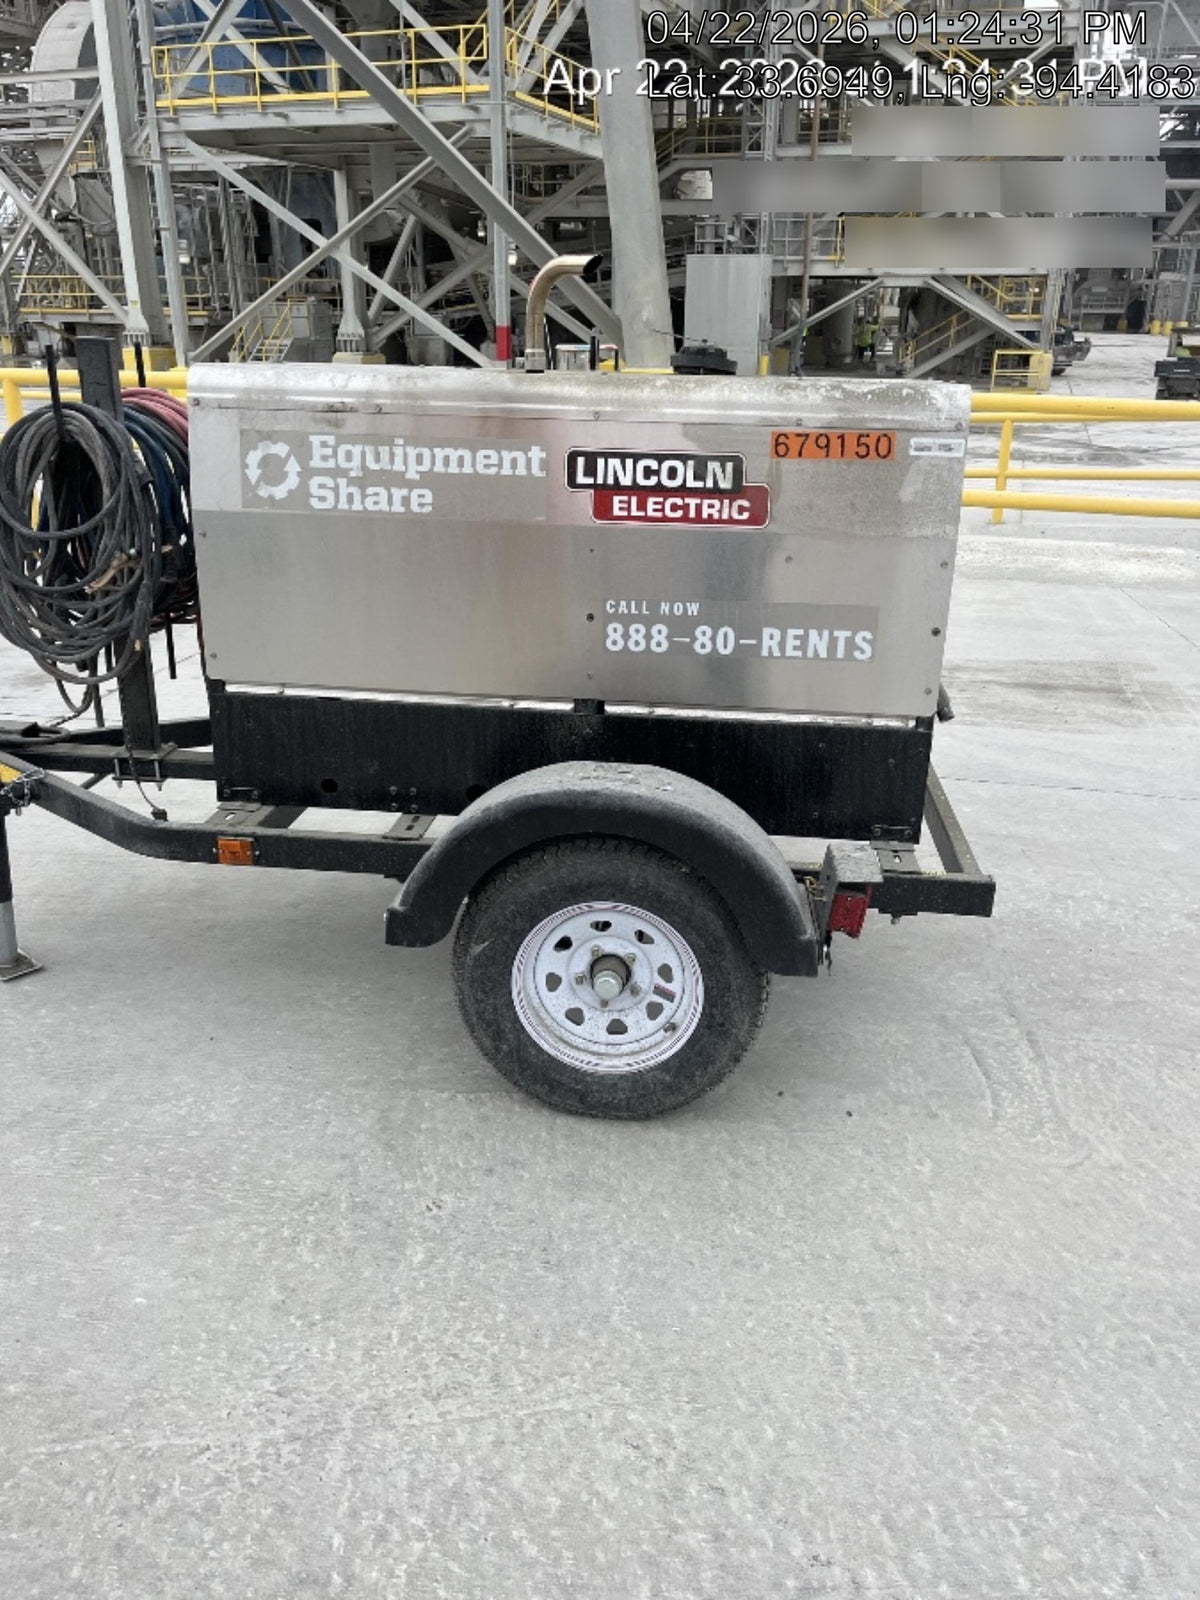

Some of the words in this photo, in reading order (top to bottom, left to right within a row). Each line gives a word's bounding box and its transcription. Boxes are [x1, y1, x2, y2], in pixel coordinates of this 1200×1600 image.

[308, 434, 548, 481] Equipment
[773, 433, 893, 459] 679150
[575, 456, 734, 490] LINCOLN
[308, 475, 434, 514] Share
[612, 495, 751, 521] ELECTRIC
[605, 599, 650, 616] CALL
[660, 601, 701, 616] NOW
[605, 622, 875, 662] 888-80-RENTS
